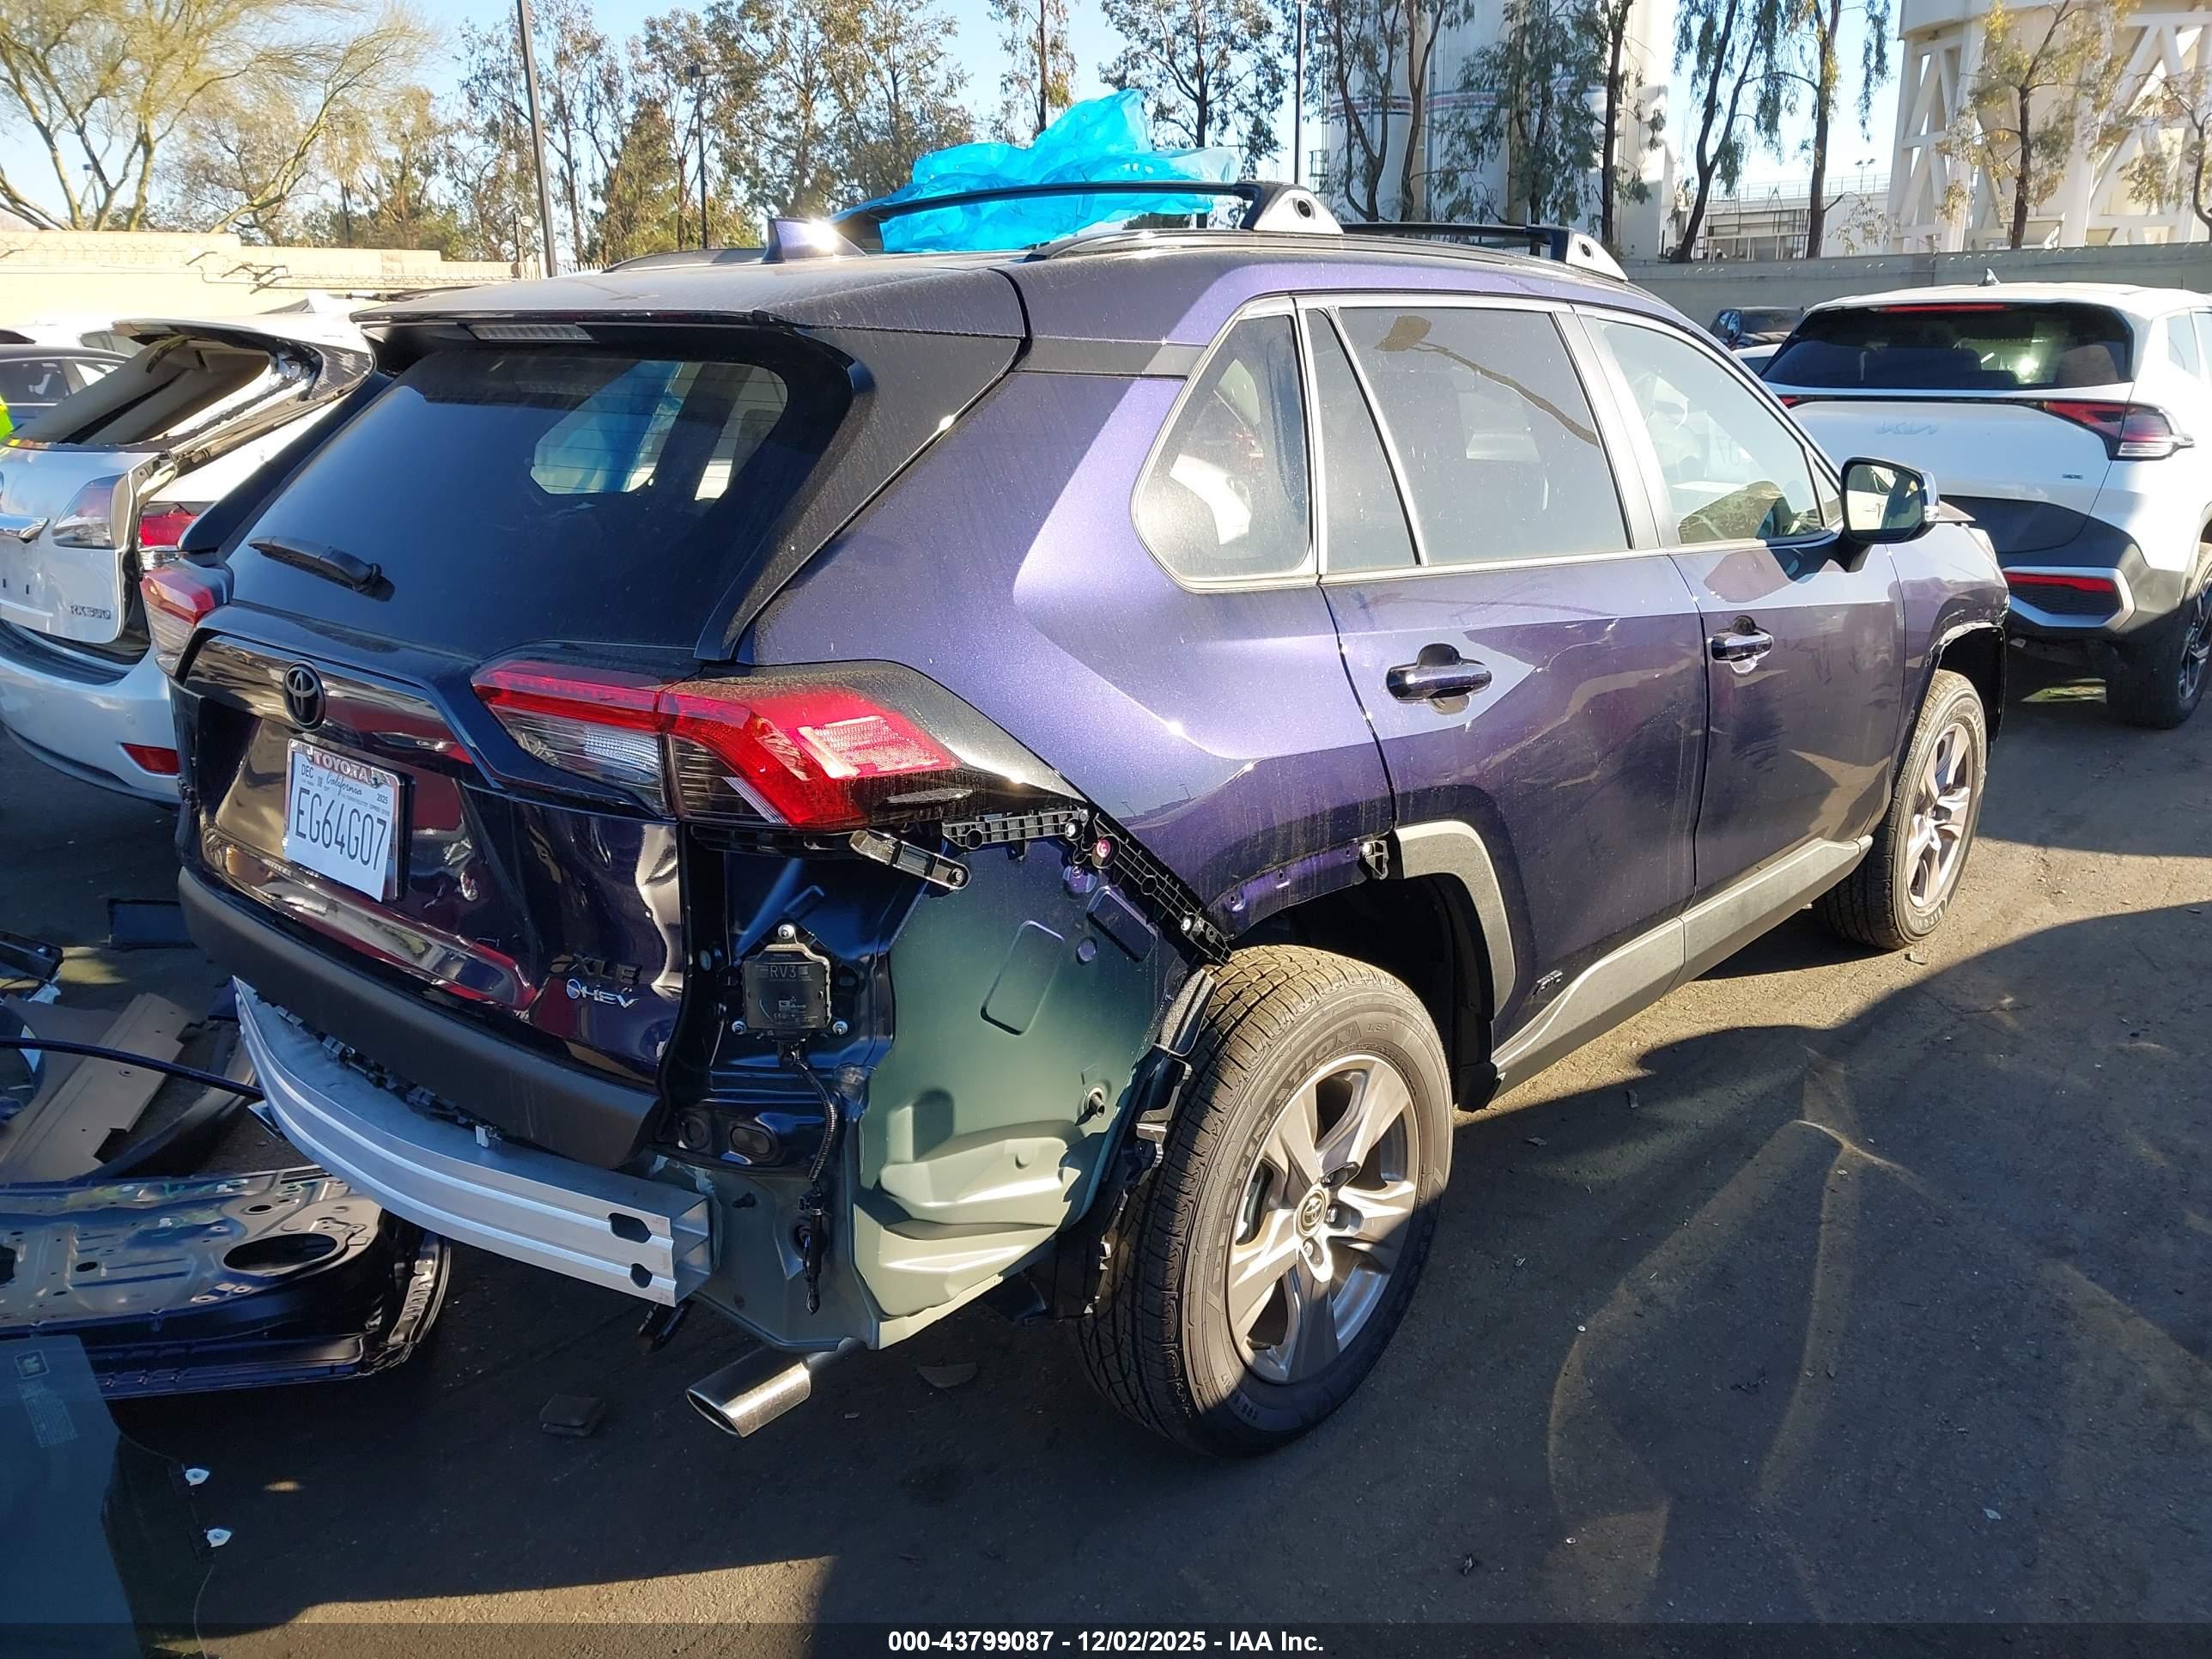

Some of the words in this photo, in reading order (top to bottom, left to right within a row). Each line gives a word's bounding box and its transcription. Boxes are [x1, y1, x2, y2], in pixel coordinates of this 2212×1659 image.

[301, 763, 314, 779] DEC
[313, 749, 371, 785] TOYOTA
[325, 771, 363, 797] California
[295, 786, 387, 871] EG64G07
[568, 953, 643, 986] XLE
